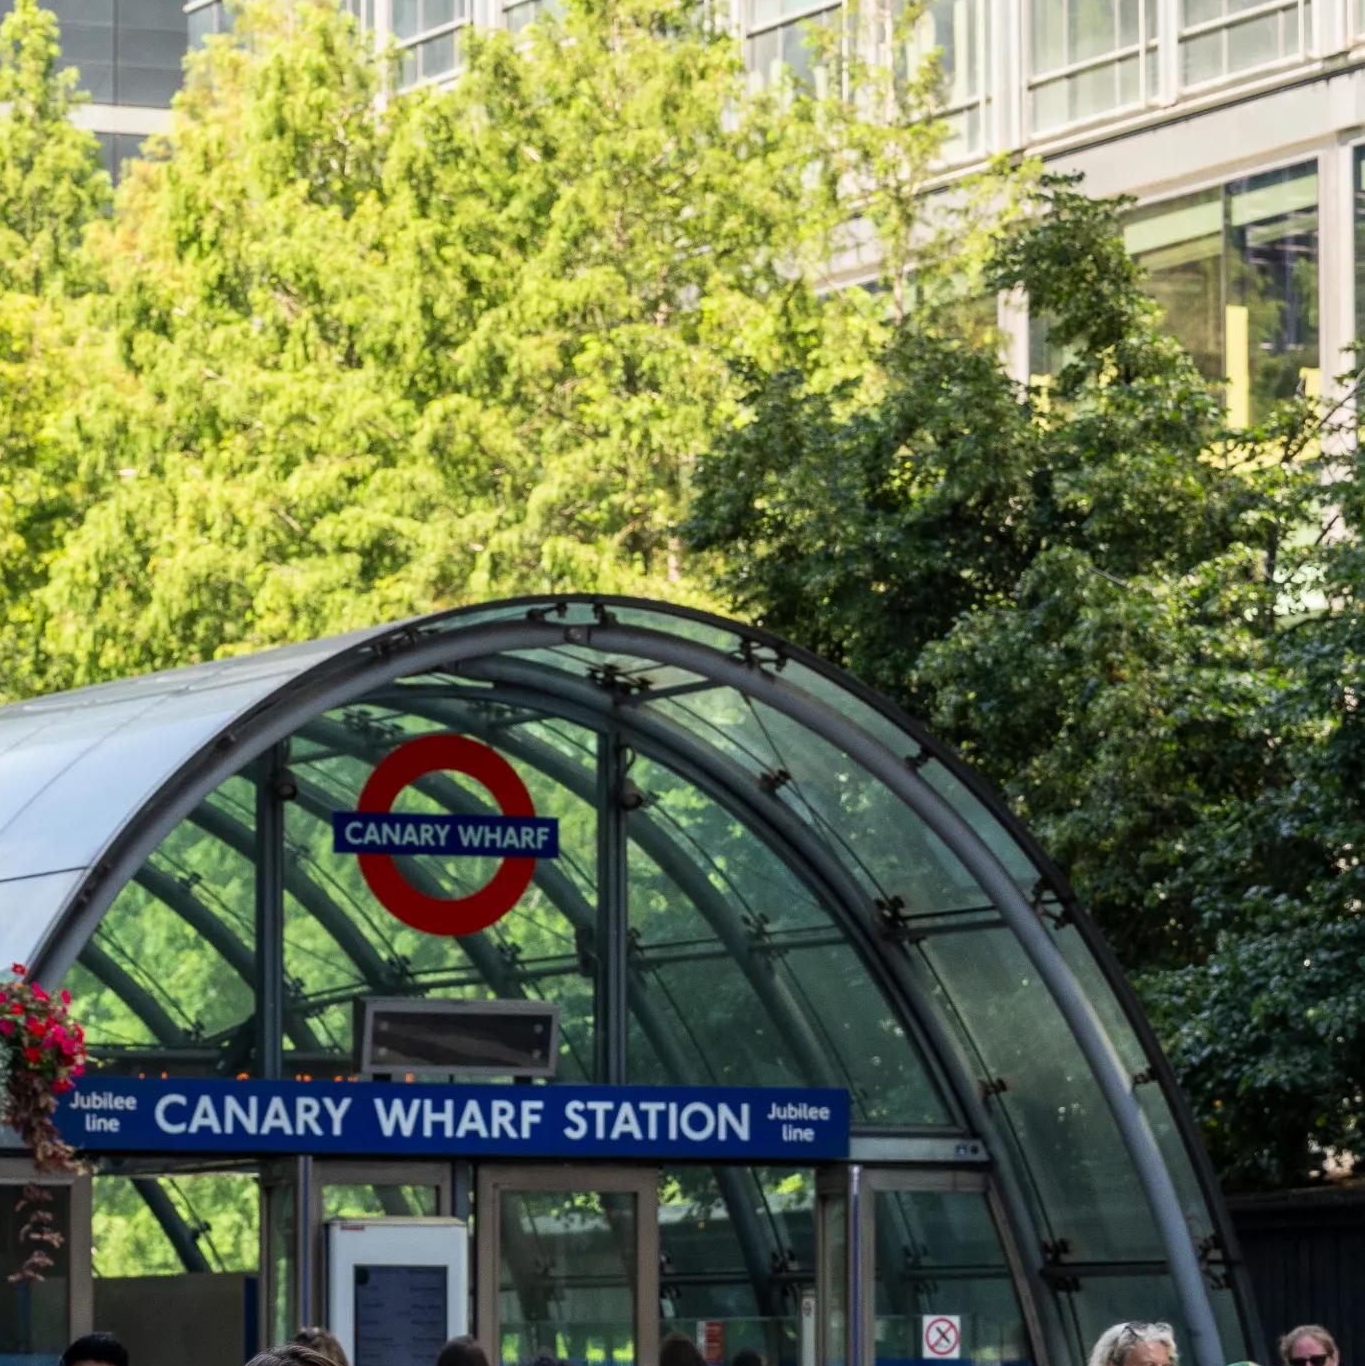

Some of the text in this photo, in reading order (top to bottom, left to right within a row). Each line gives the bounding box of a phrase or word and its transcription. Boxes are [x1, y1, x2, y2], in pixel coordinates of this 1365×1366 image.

[344, 821, 550, 849] CANARY WHARF
[69, 1091, 137, 1110] Jubilee
[154, 1093, 751, 1142] CANARY WHARF STATION
[767, 1101, 830, 1121] Jubilee
[85, 1113, 121, 1133] line
[781, 1122, 816, 1142] line
